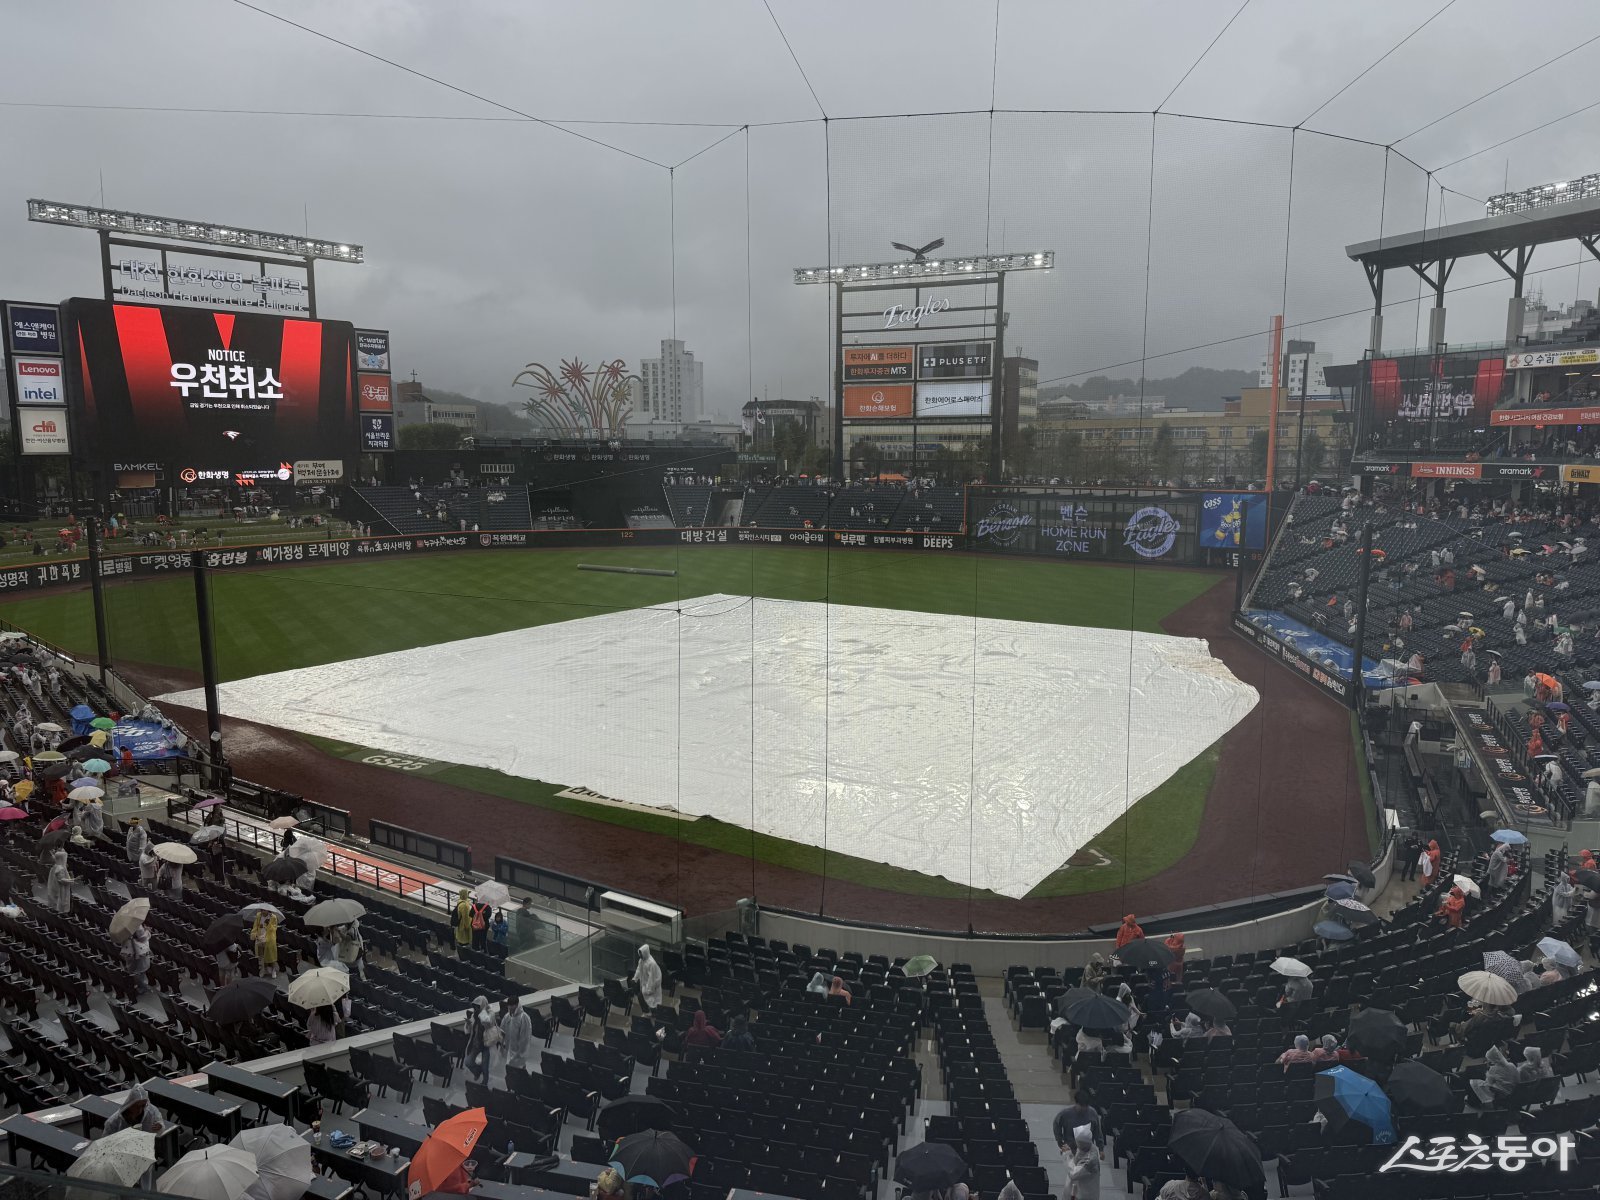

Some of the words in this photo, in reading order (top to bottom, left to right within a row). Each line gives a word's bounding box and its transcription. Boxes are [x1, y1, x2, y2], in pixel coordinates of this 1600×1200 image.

[119, 259, 160, 282] 대전
[167, 264, 243, 291] 한화생명
[252, 274, 304, 296] 볼파크
[121, 286, 169, 299] Daejeon
[172, 290, 225, 305] Hanwha
[229, 297, 253, 308] Life
[257, 298, 305, 313] Ballpark
[883, 295, 950, 329] Eagles
[40, 331, 56, 340] 병원
[358, 336, 387, 345] K-water
[207, 349, 246, 362] NOTICE
[939, 357, 964, 366] PLUS
[967, 356, 987, 364] ETF
[22, 365, 56, 374] Lenovo
[169, 363, 284, 399] 우천취소
[23, 386, 57, 400] intel
[859, 404, 897, 413] 한화손해보험
[113, 462, 163, 471] BAMKEL
[1435, 466, 1475, 476] INNINGS
[1499, 467, 1533, 476] aramark
[198, 470, 230, 479] 한화생명
[1060, 504, 1089, 522] 벤슨
[681, 530, 728, 543] 대방건설
[1041, 525, 1078, 538] HOME
[1080, 526, 1107, 539] RUN
[1123, 516, 1181, 546] Eagles
[923, 537, 954, 549] DEEPS
[1056, 540, 1090, 552] ZONE
[263, 546, 304, 562] 예가정성
[308, 541, 350, 557] 로제비앙
[115, 561, 133, 574] 병원
[140, 553, 192, 570] 마켓영동
[361, 755, 430, 770] GS25
